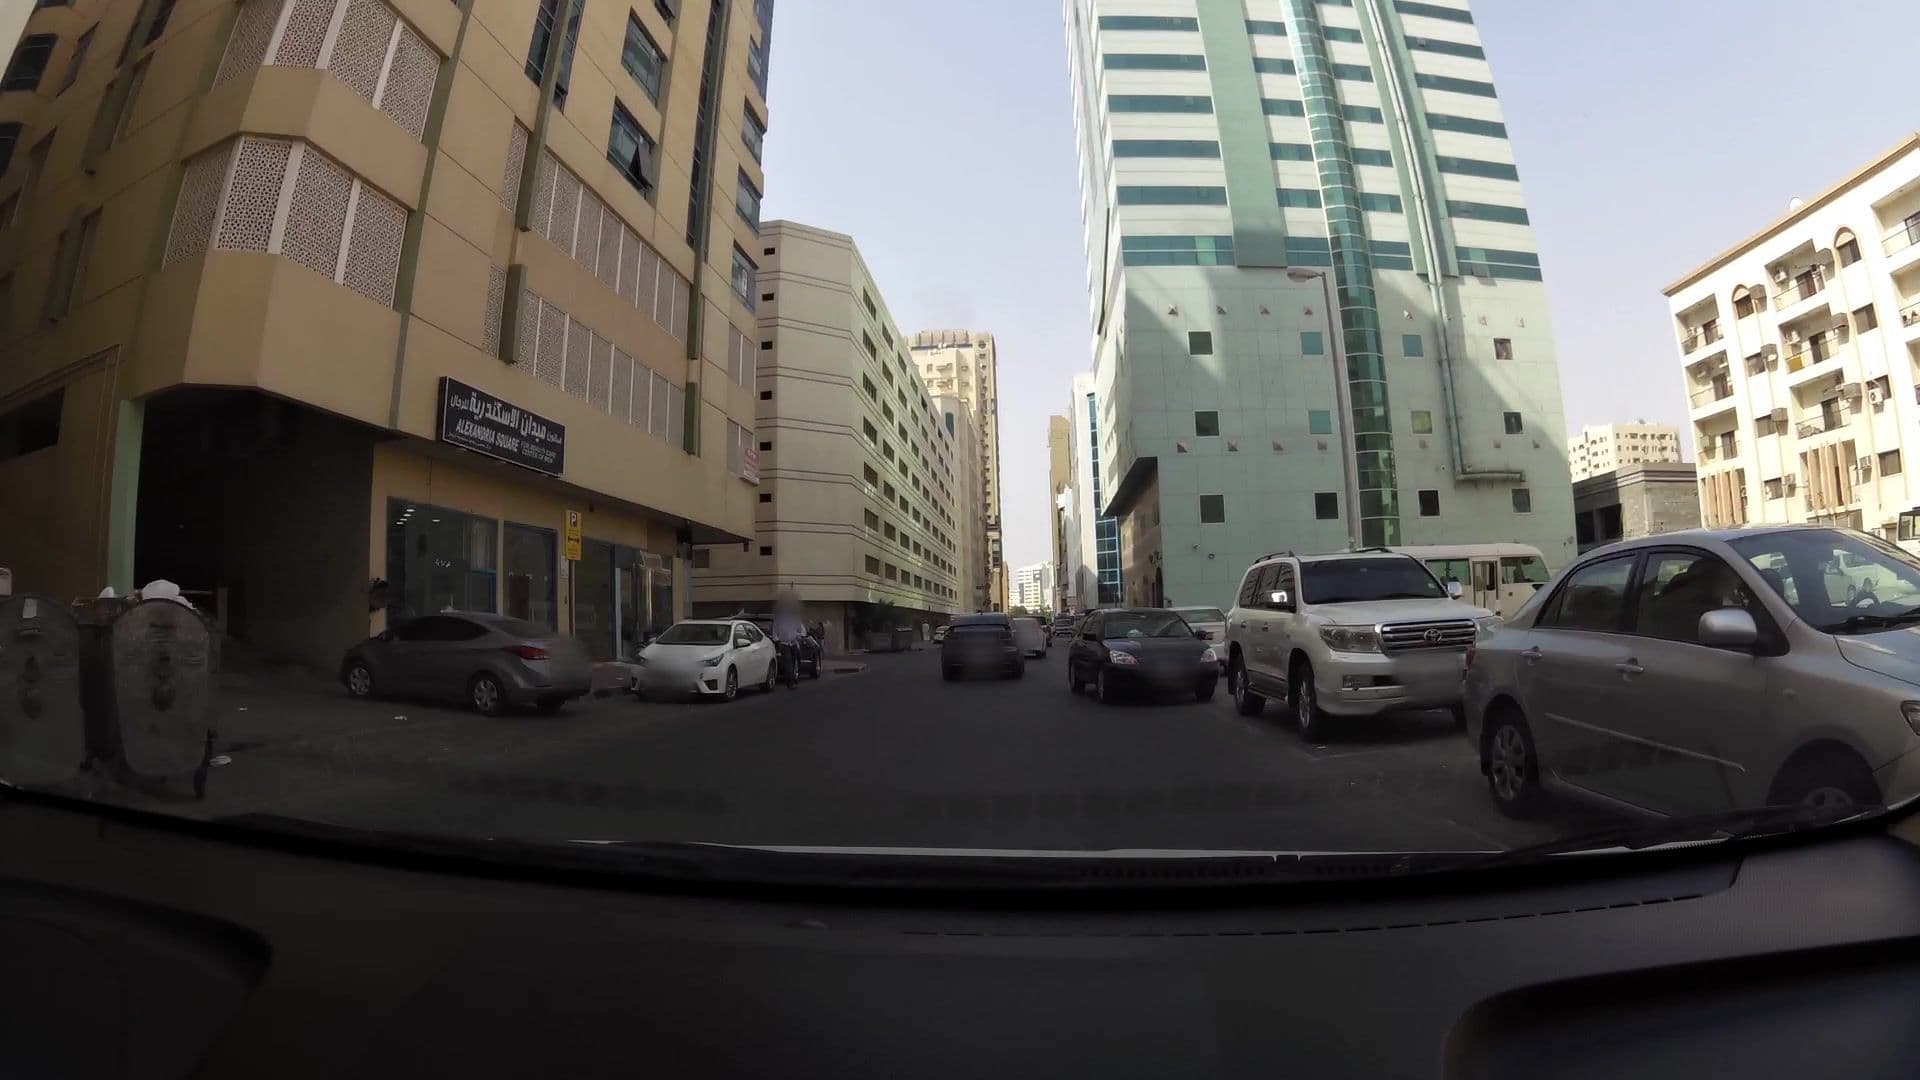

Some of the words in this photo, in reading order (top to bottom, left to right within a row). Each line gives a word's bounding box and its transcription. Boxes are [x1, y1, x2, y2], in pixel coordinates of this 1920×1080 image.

[450, 394, 469, 411] للرجال
[456, 418, 496, 445] ALEXANDRIA
[495, 432, 520, 452] SQUARE
[520, 414, 547, 442] ميدان
